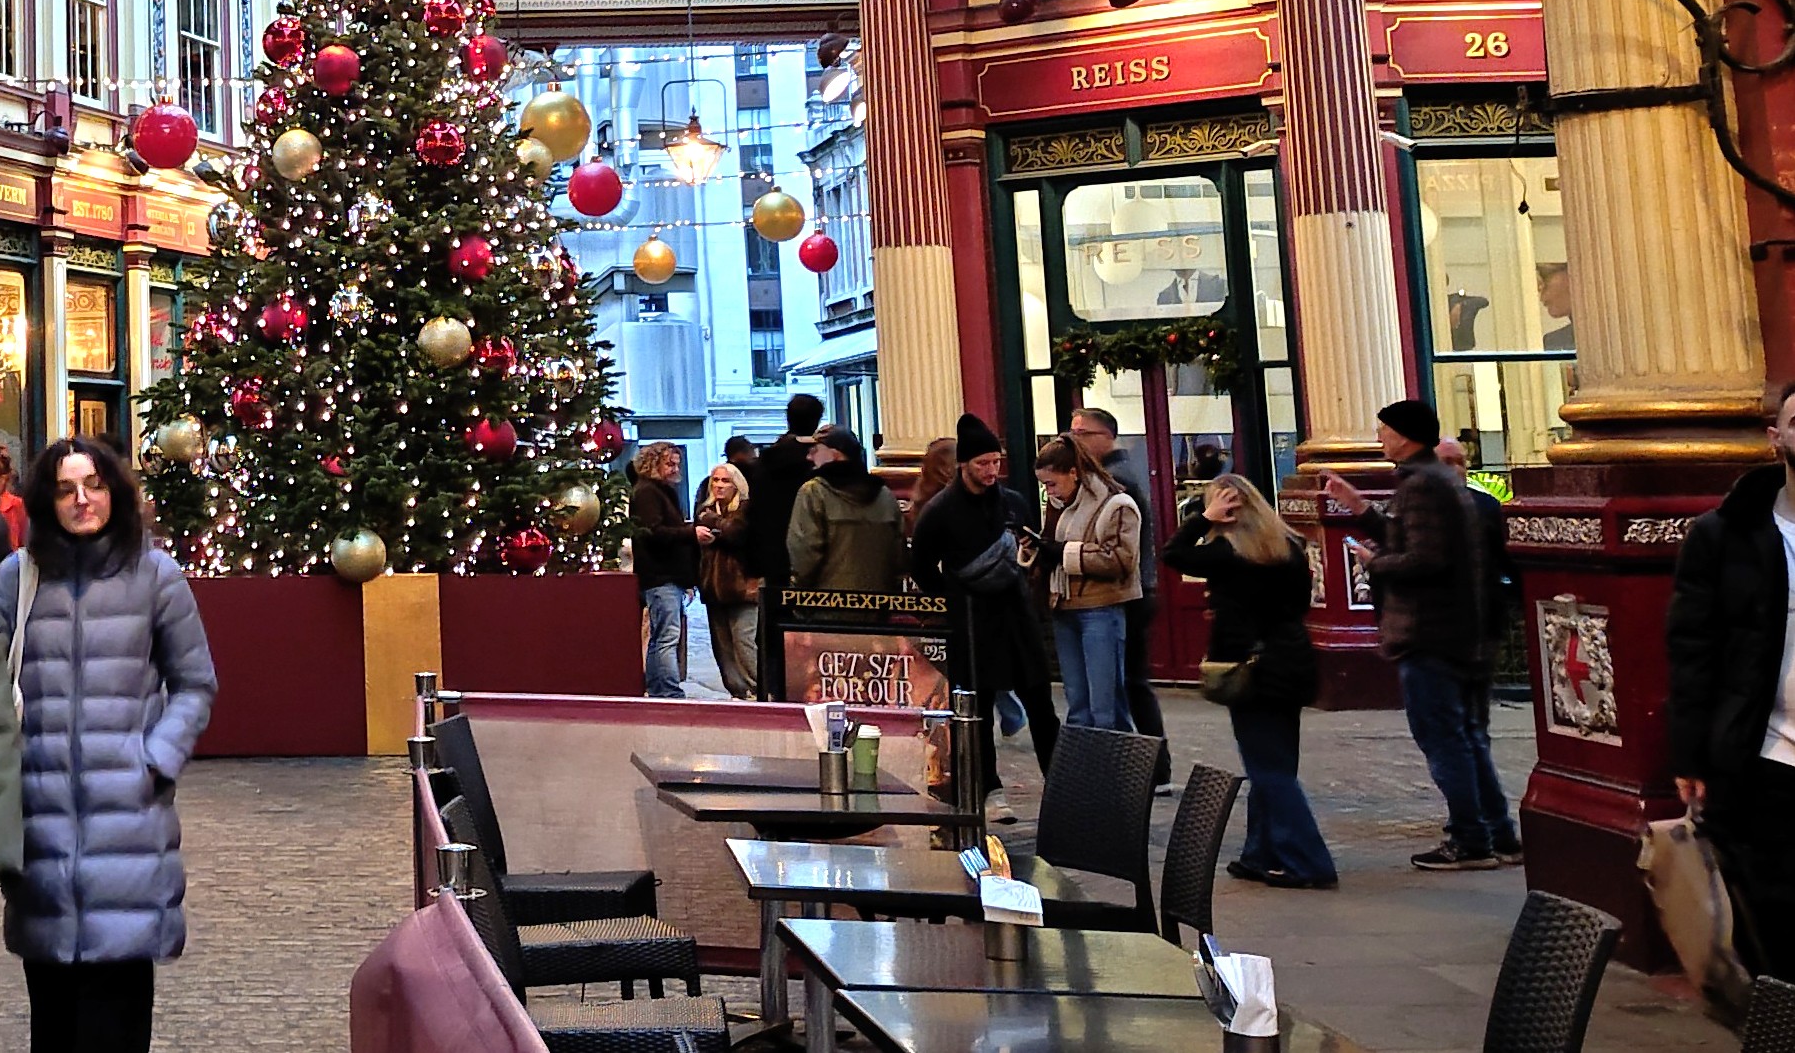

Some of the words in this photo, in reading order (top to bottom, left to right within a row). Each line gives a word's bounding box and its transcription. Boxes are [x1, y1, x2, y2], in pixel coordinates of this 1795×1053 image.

[1465, 32, 1509, 58] 26
[1071, 56, 1170, 90] REISS
[781, 590, 948, 613] PIZZAEXPRESS
[818, 651, 864, 677] GET
[868, 654, 915, 680] SET
[820, 677, 865, 703] FOR
[867, 679, 914, 706] OUR
